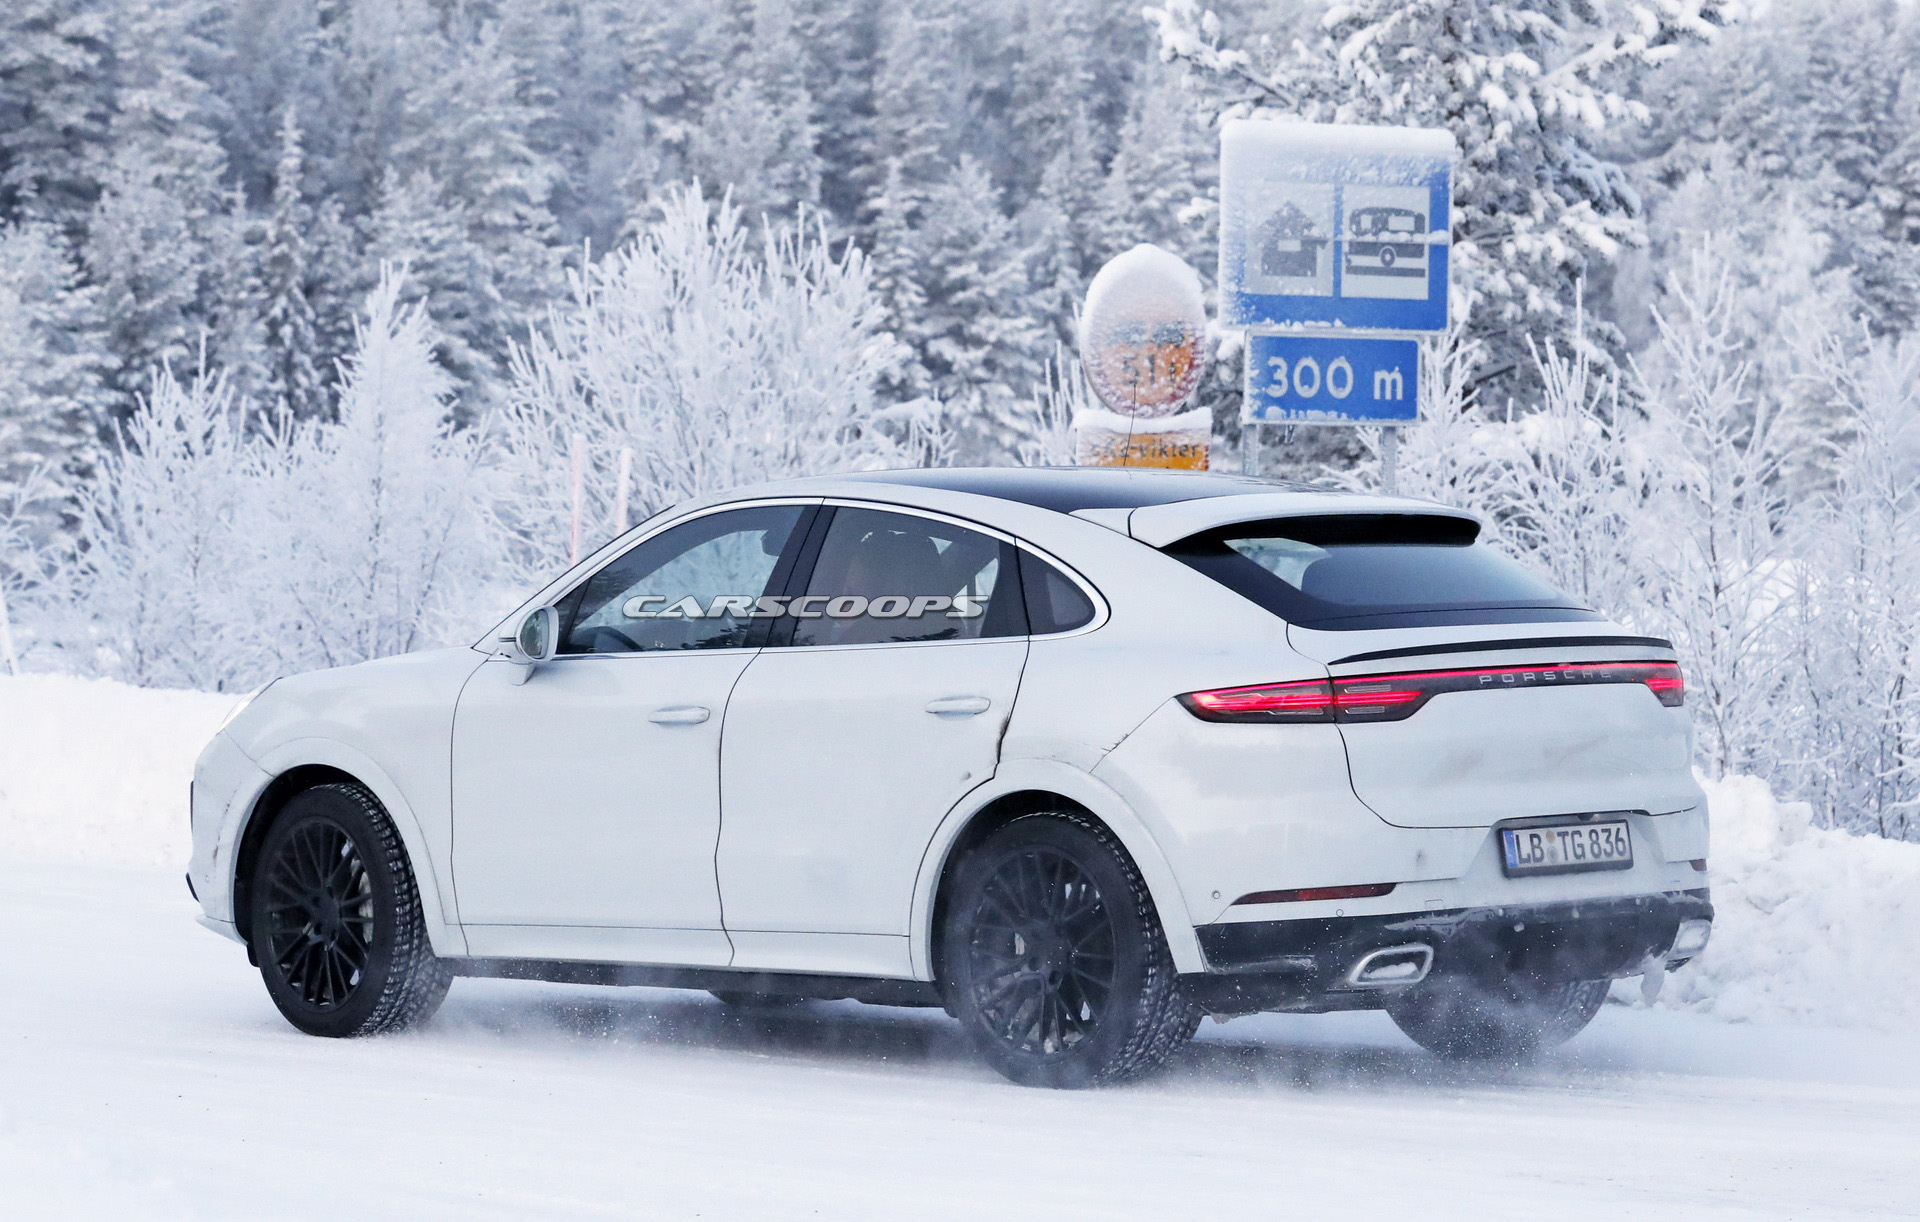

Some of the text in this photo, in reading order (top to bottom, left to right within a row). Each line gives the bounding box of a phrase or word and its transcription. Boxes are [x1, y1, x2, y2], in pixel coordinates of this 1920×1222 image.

[1266, 356, 1403, 400] 300 m
[1478, 670, 1612, 685] PORSCHE
[1515, 827, 1627, 864] LB TG 836
